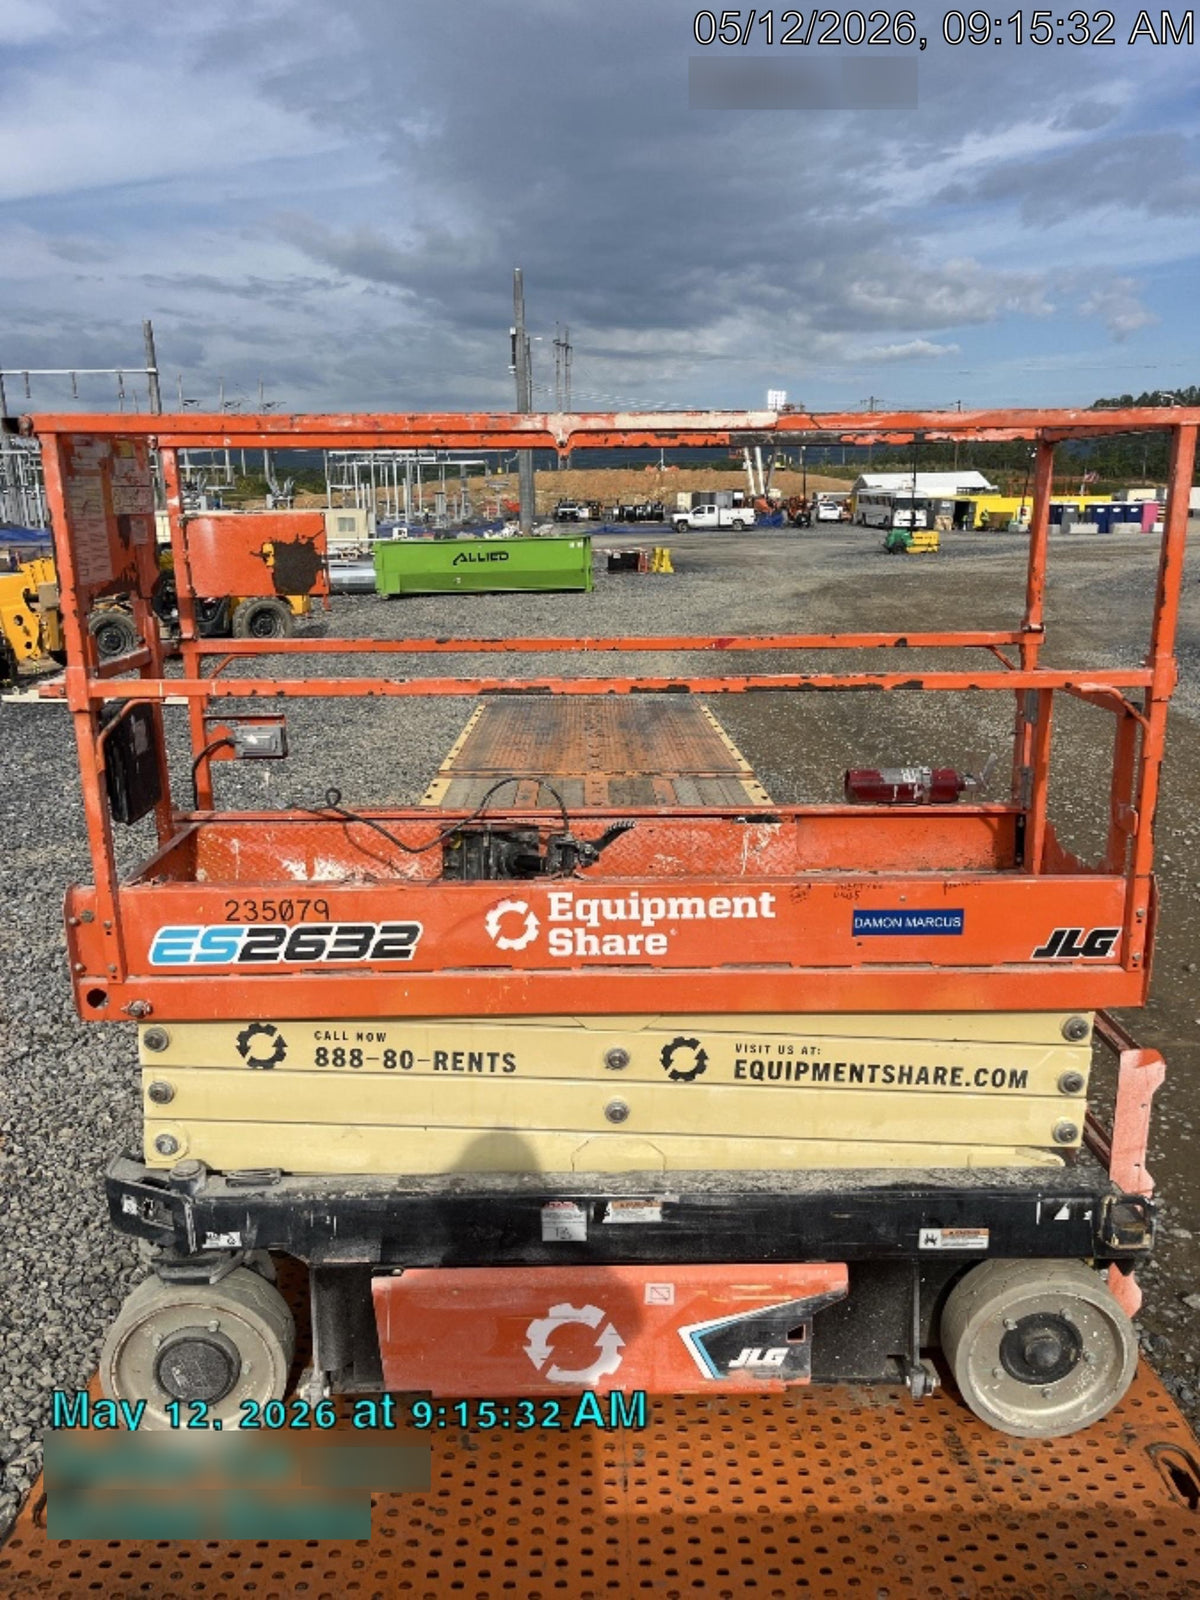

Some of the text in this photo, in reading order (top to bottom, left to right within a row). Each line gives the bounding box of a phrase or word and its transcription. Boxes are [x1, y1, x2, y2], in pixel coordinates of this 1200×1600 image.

[453, 551, 509, 566] ALLIED
[225, 899, 330, 922] 235079
[547, 891, 776, 927] Equipment
[854, 916, 961, 928] DAMON MARCUS
[149, 921, 424, 966] ES2632
[548, 927, 668, 957] Share
[1030, 927, 1122, 960] JLG
[314, 1030, 387, 1043] CALL NOW
[314, 1046, 517, 1073] 888-80-RENTS
[735, 1043, 822, 1056] VISIT US AT:
[733, 1058, 1029, 1089] EQUIPMENTSHARE.COM
[728, 1347, 790, 1368] JLG
